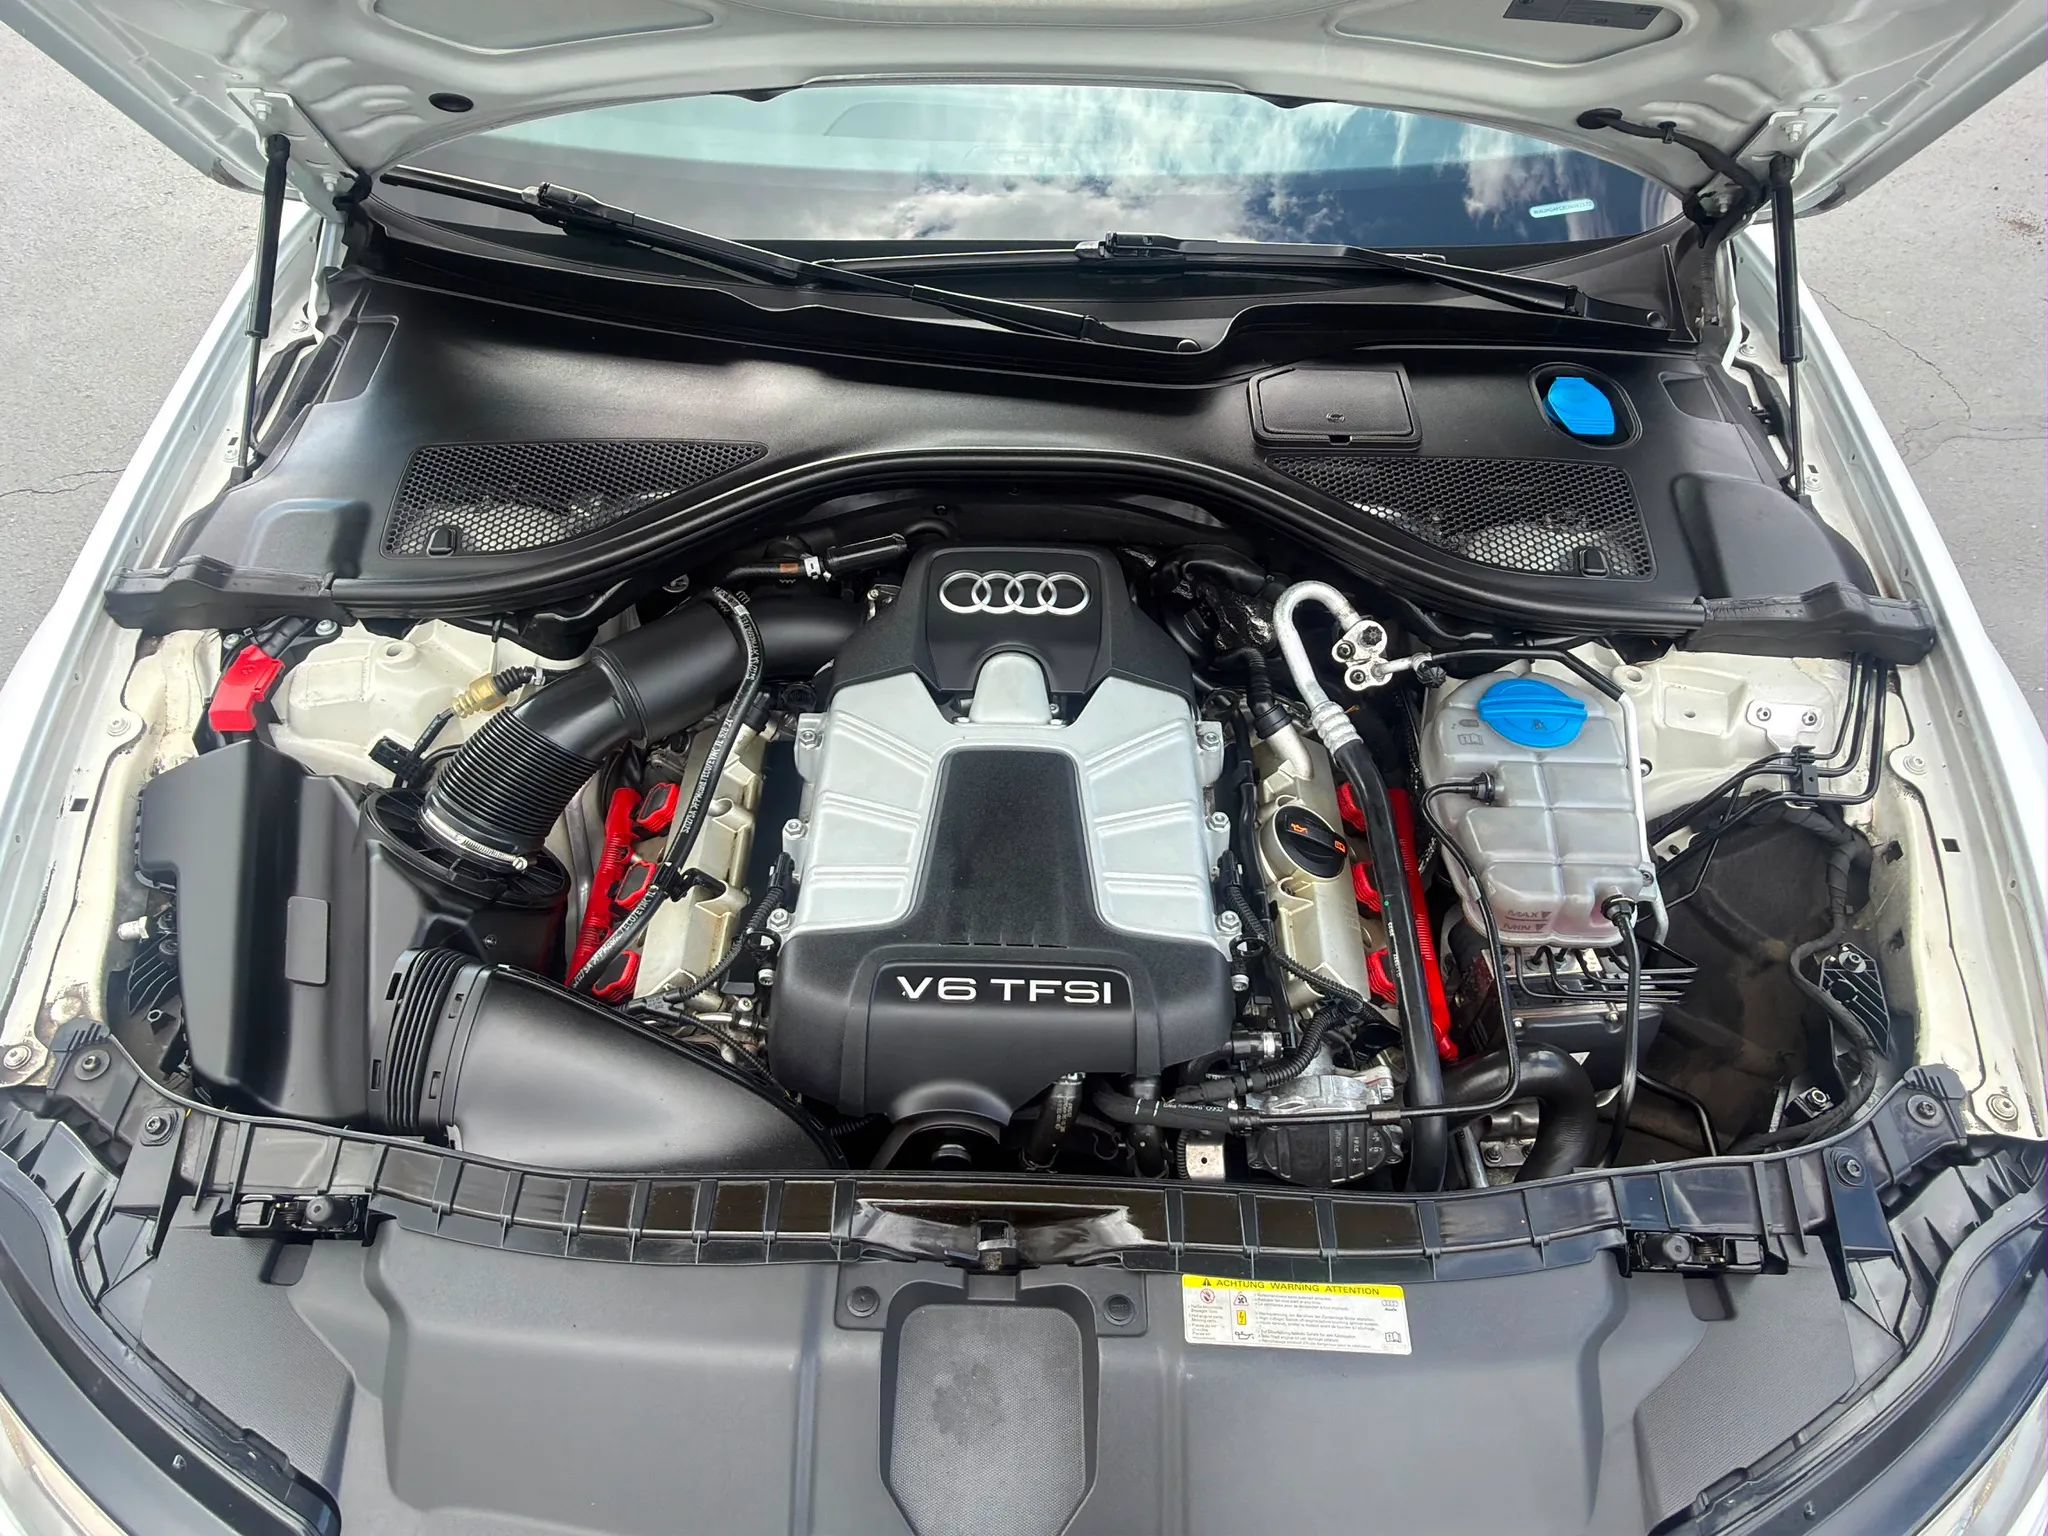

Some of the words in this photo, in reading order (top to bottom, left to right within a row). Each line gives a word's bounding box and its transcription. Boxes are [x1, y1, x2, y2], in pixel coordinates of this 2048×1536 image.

[896, 976, 978, 1001] V6
[990, 978, 1112, 1004] TFSI
[1215, 1279, 1265, 1290] ACHTUNG
[1270, 1281, 1320, 1293] WARNING
[1325, 1284, 1381, 1296] ATTENTION
